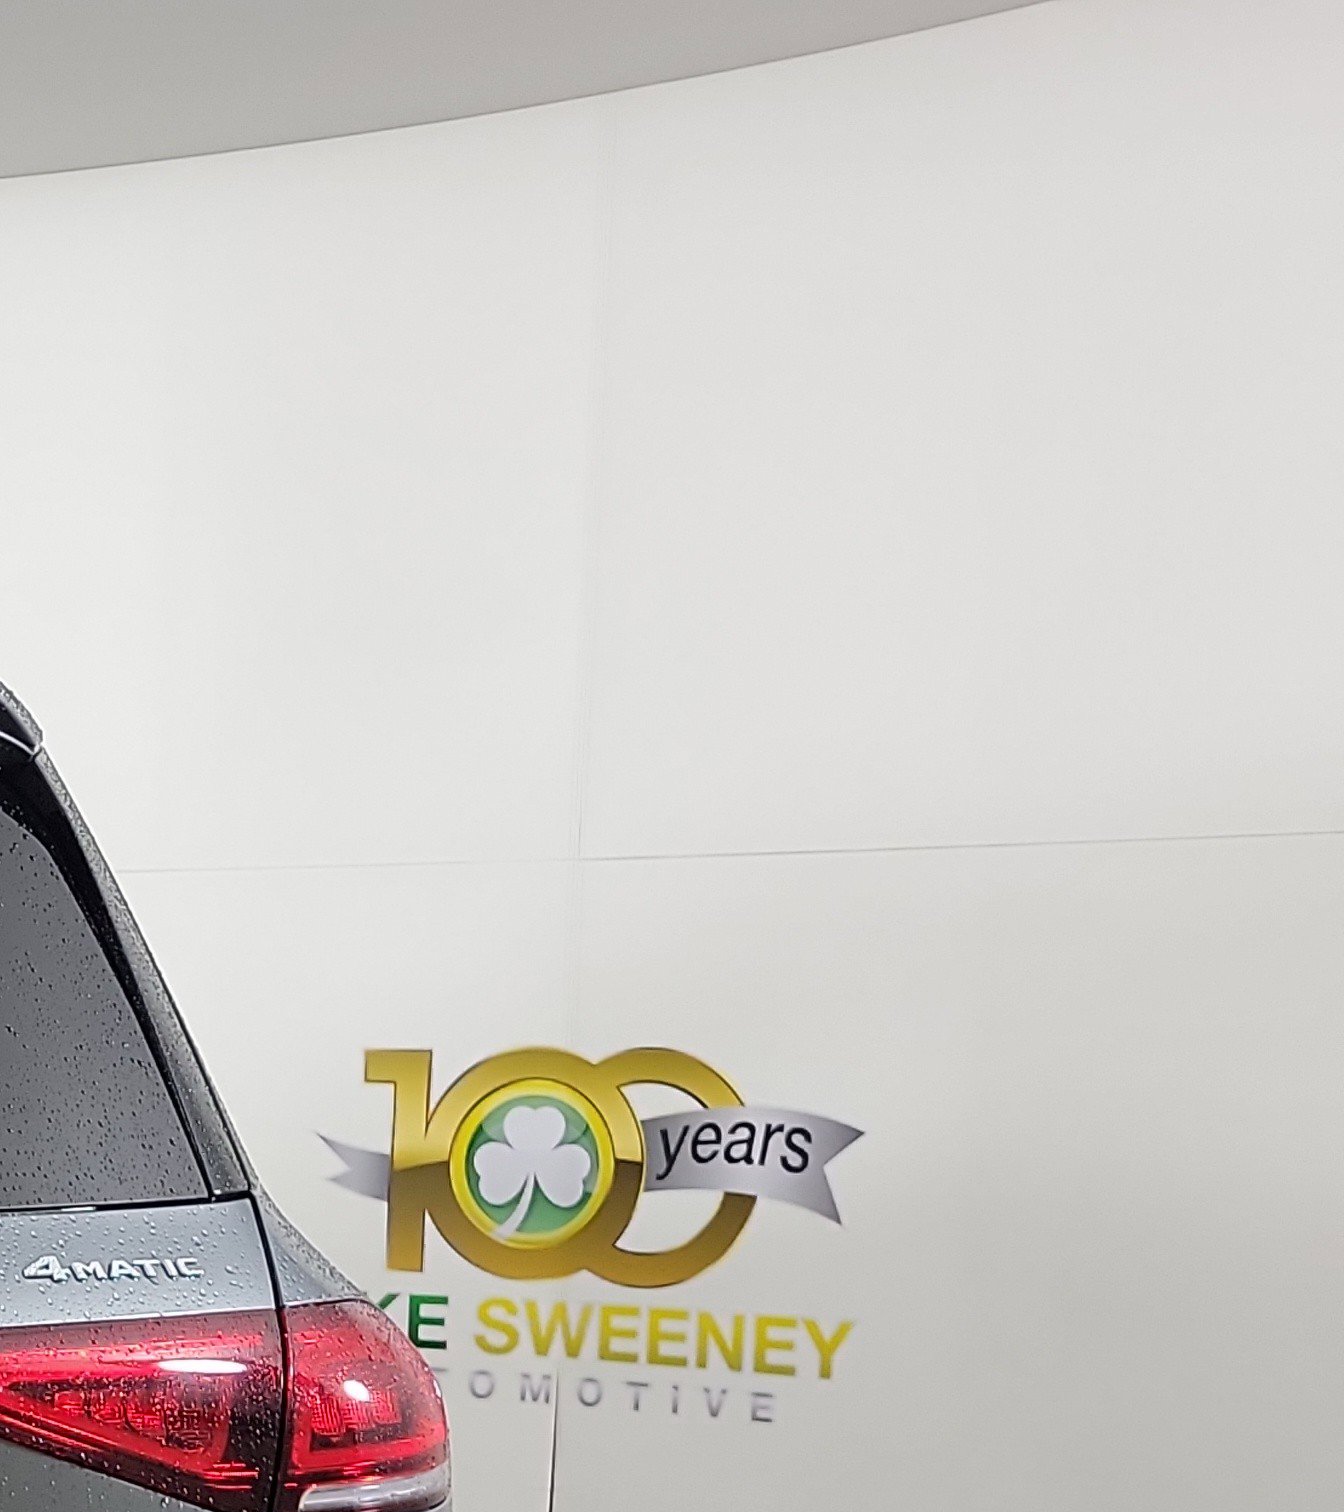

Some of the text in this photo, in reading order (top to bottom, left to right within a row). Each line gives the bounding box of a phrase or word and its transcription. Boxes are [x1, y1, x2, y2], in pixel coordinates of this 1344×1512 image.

[364, 1046, 813, 1288] 100 years
[22, 1254, 205, 1283] 4MATIC
[473, 1296, 856, 1380] SWEENEY
[432, 1366, 774, 1423] OMOTIVE
